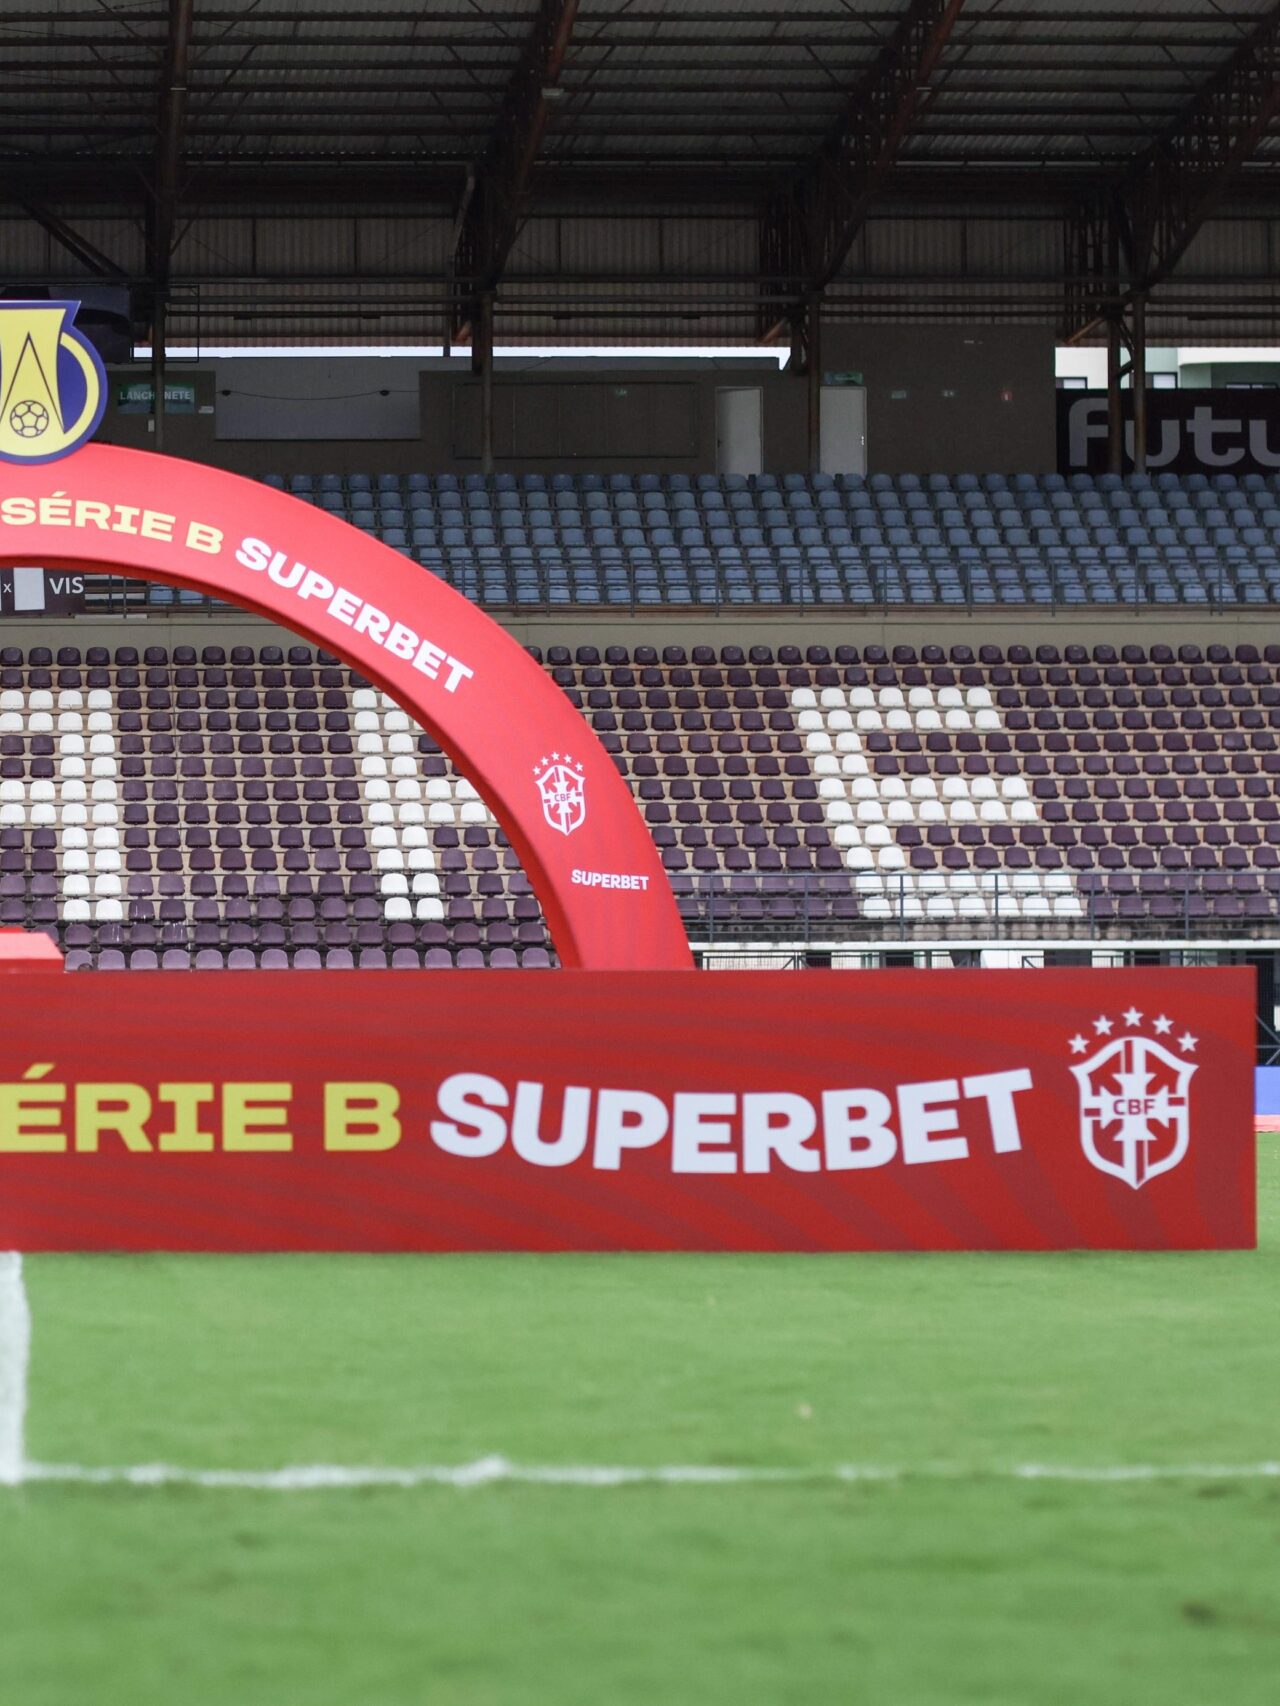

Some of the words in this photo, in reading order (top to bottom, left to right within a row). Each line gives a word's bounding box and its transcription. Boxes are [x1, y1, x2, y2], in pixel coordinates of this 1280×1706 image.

[119, 391, 191, 400] LANCHNETE
[1, 491, 176, 542] SÉRIE
[185, 520, 224, 555] B
[235, 537, 474, 693] SUPERBET
[49, 577, 84, 595] VIS
[554, 793, 572, 802] CBF
[571, 869, 649, 890] SUPERBET
[1113, 1099, 1155, 1115] CBF
[324, 1082, 401, 1152] B
[430, 1073, 1033, 1173] SUPERBET
